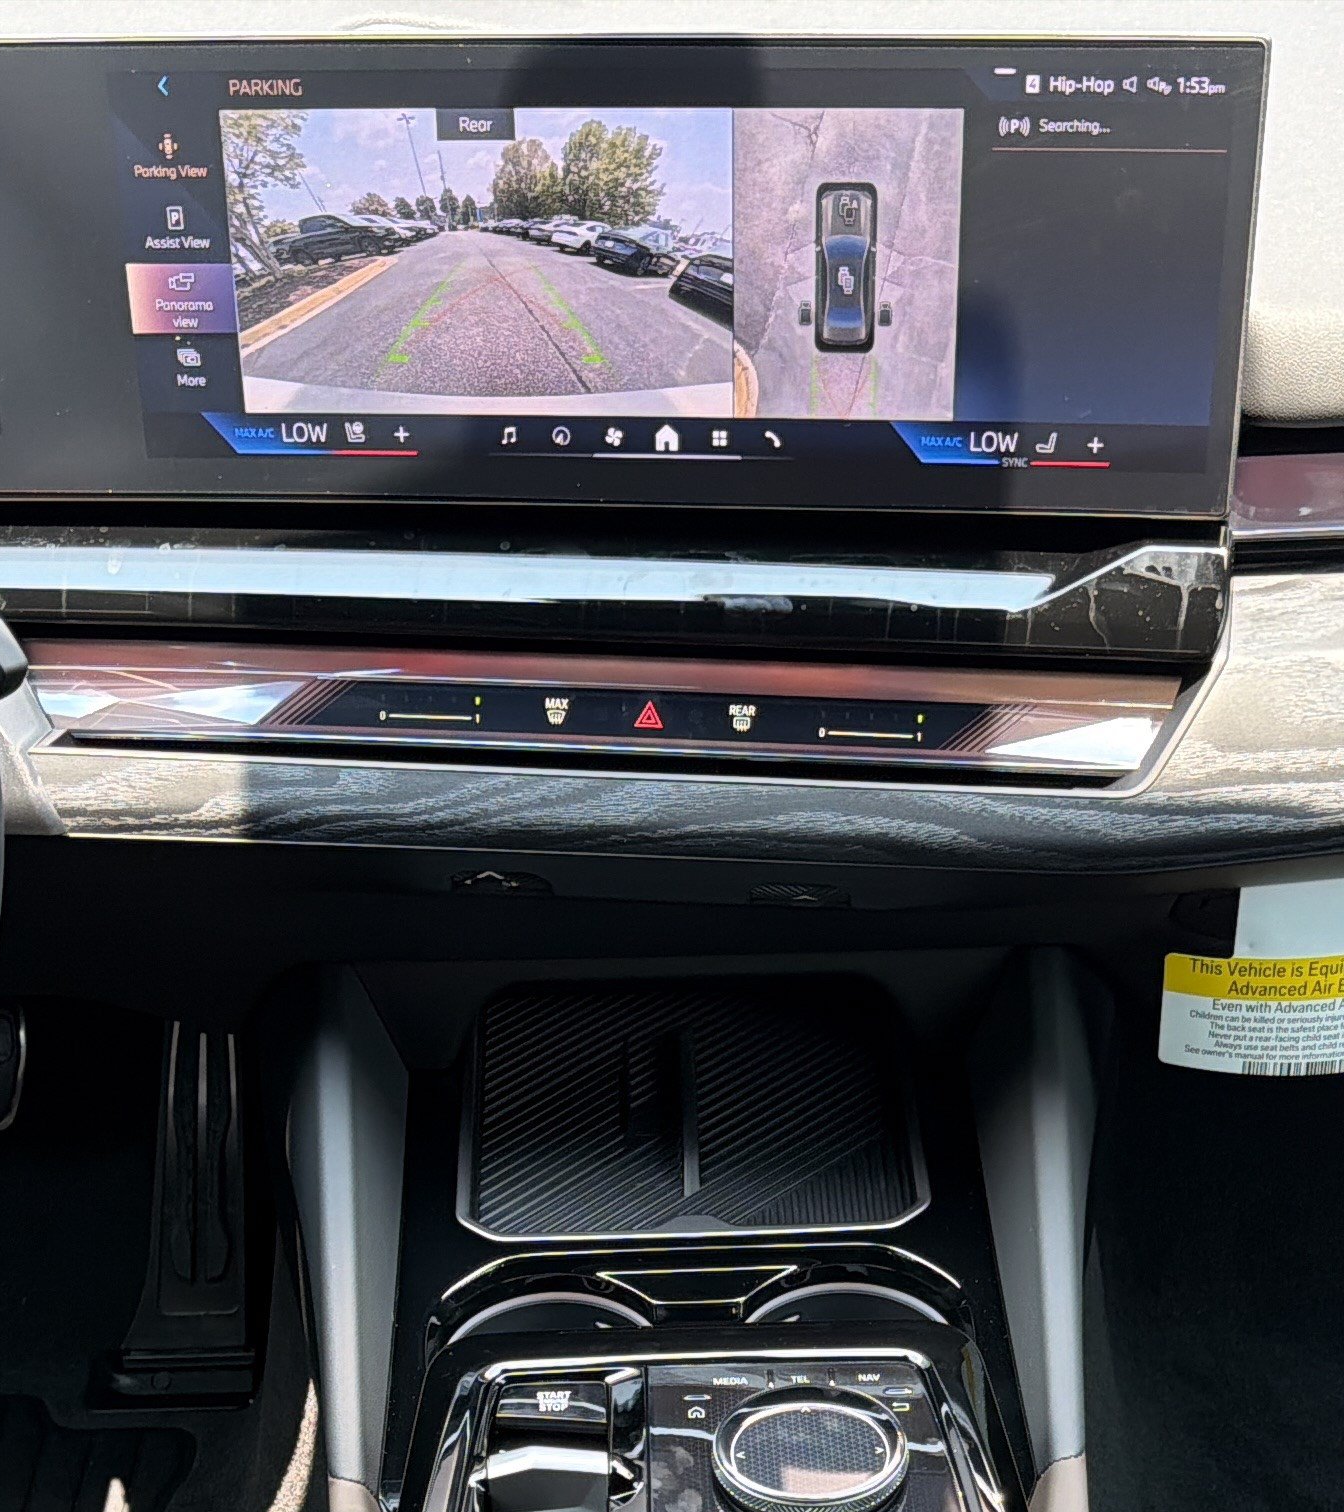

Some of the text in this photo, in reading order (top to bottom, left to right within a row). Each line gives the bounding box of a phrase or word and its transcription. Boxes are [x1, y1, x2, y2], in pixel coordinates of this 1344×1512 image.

[228, 78, 303, 96] PARKING
[1049, 75, 1115, 95] Hip-Hop
[458, 116, 493, 132] Rear
[1038, 118, 1111, 136] Searching...
[133, 164, 208, 181] Parking View
[145, 235, 211, 249] Assist View
[155, 299, 214, 312] Panorama
[172, 315, 199, 328] view
[176, 373, 207, 387] More
[234, 428, 257, 439] MAX
[280, 422, 328, 443] LOW
[920, 431, 1019, 453] MAX A/C LOW
[1001, 457, 1029, 468] SYNC
[544, 697, 570, 710] MAX
[728, 704, 756, 716] REAR
[818, 727, 826, 738] 0
[1188, 957, 1223, 976] This
[1227, 961, 1287, 978] Vehicle
[1290, 961, 1304, 978] is
[1226, 979, 1308, 997] Advanced
[1309, 979, 1335, 996] Air
[1211, 998, 1242, 1012] Even
[1245, 1001, 1272, 1014] with
[1273, 999, 1336, 1014] Advanced
[1189, 1009, 1224, 1020] Children
[1225, 1015, 1240, 1023] can
[1241, 1015, 1252, 1023] be
[1254, 1015, 1275, 1024] killed
[1287, 1014, 1323, 1025] seriously
[1210, 1021, 1225, 1030] The
[1226, 1024, 1246, 1032] back
[1247, 1025, 1265, 1033] seat
[1266, 1025, 1274, 1033] is
[1275, 1025, 1290, 1033] the
[1290, 1024, 1316, 1034] safest
[1316, 1022, 1338, 1033] place
[1208, 1030, 1232, 1041] Never
[1233, 1034, 1247, 1043] put
[1255, 1034, 1301, 1044] rear-facing
[1301, 1034, 1321, 1043] child
[1322, 1032, 1340, 1041] seat
[1184, 1043, 1200, 1054] See
[1201, 1048, 1233, 1059] owner's
[1235, 1052, 1265, 1060] manual
[1265, 1053, 1277, 1061] for
[1213, 1039, 1243, 1051] Always
[1260, 1044, 1277, 1052] seat
[1278, 1043, 1299, 1052] belts
[1300, 1043, 1316, 1051] and
[1317, 1041, 1337, 1051] child
[712, 1375, 749, 1387] MEDIA
[789, 1374, 811, 1385] TEL
[857, 1372, 881, 1383] NAV
[536, 1390, 572, 1400] START
[538, 1402, 569, 1412] STOP
